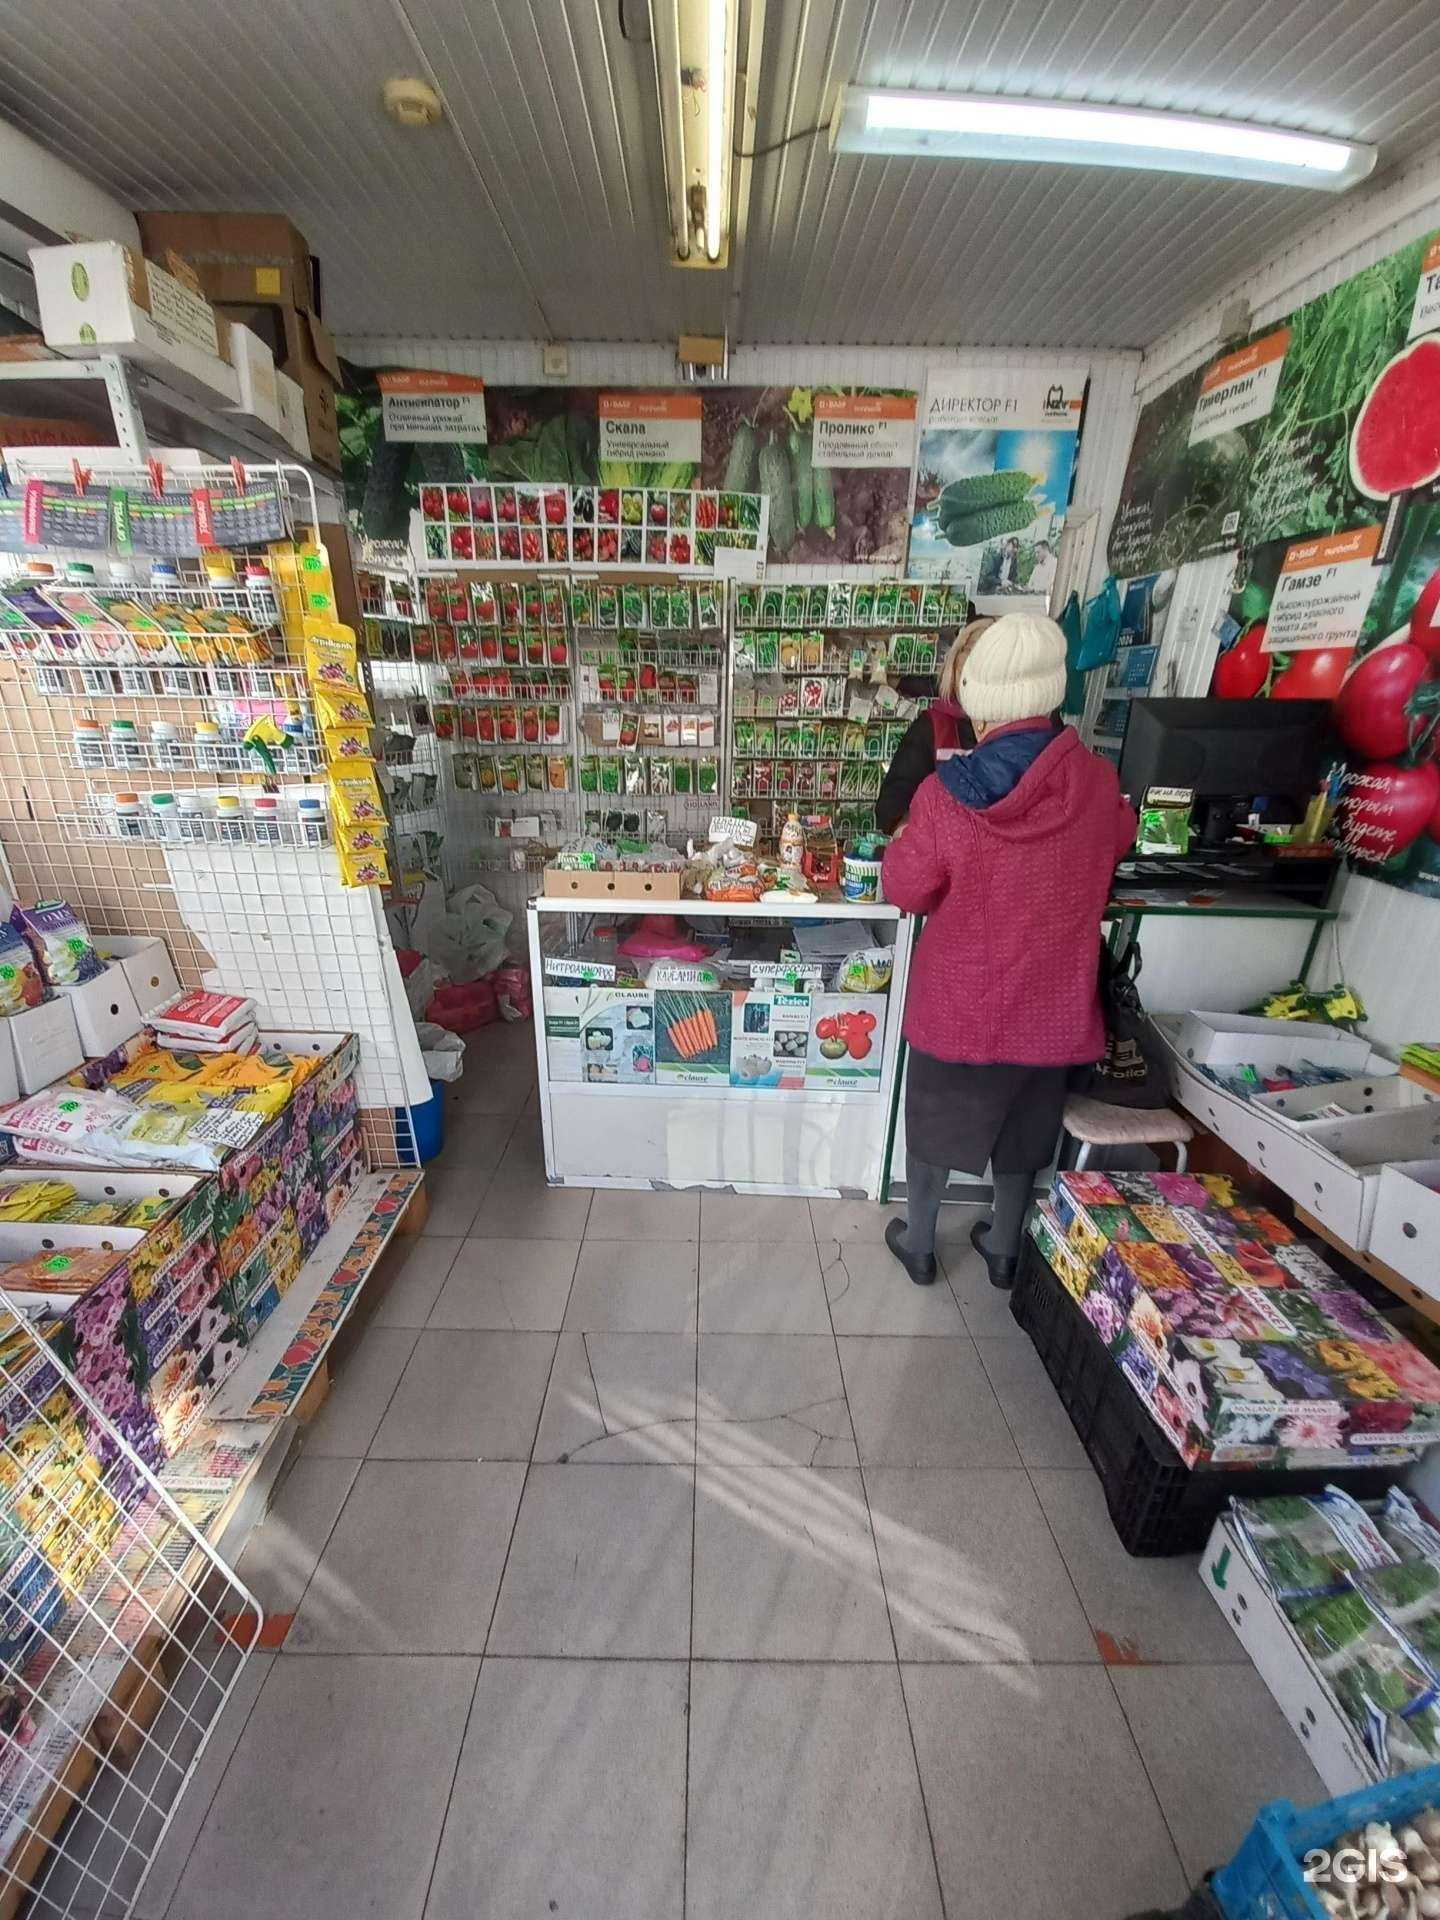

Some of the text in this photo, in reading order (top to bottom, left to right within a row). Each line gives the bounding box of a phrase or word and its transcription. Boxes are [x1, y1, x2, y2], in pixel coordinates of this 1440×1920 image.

[929, 398, 1000, 414] ДИРЕКТОР
[1281, 567, 1338, 593] Гамзе F1
[684, 1073, 708, 1083] clause
[833, 1078, 858, 1087] clause
